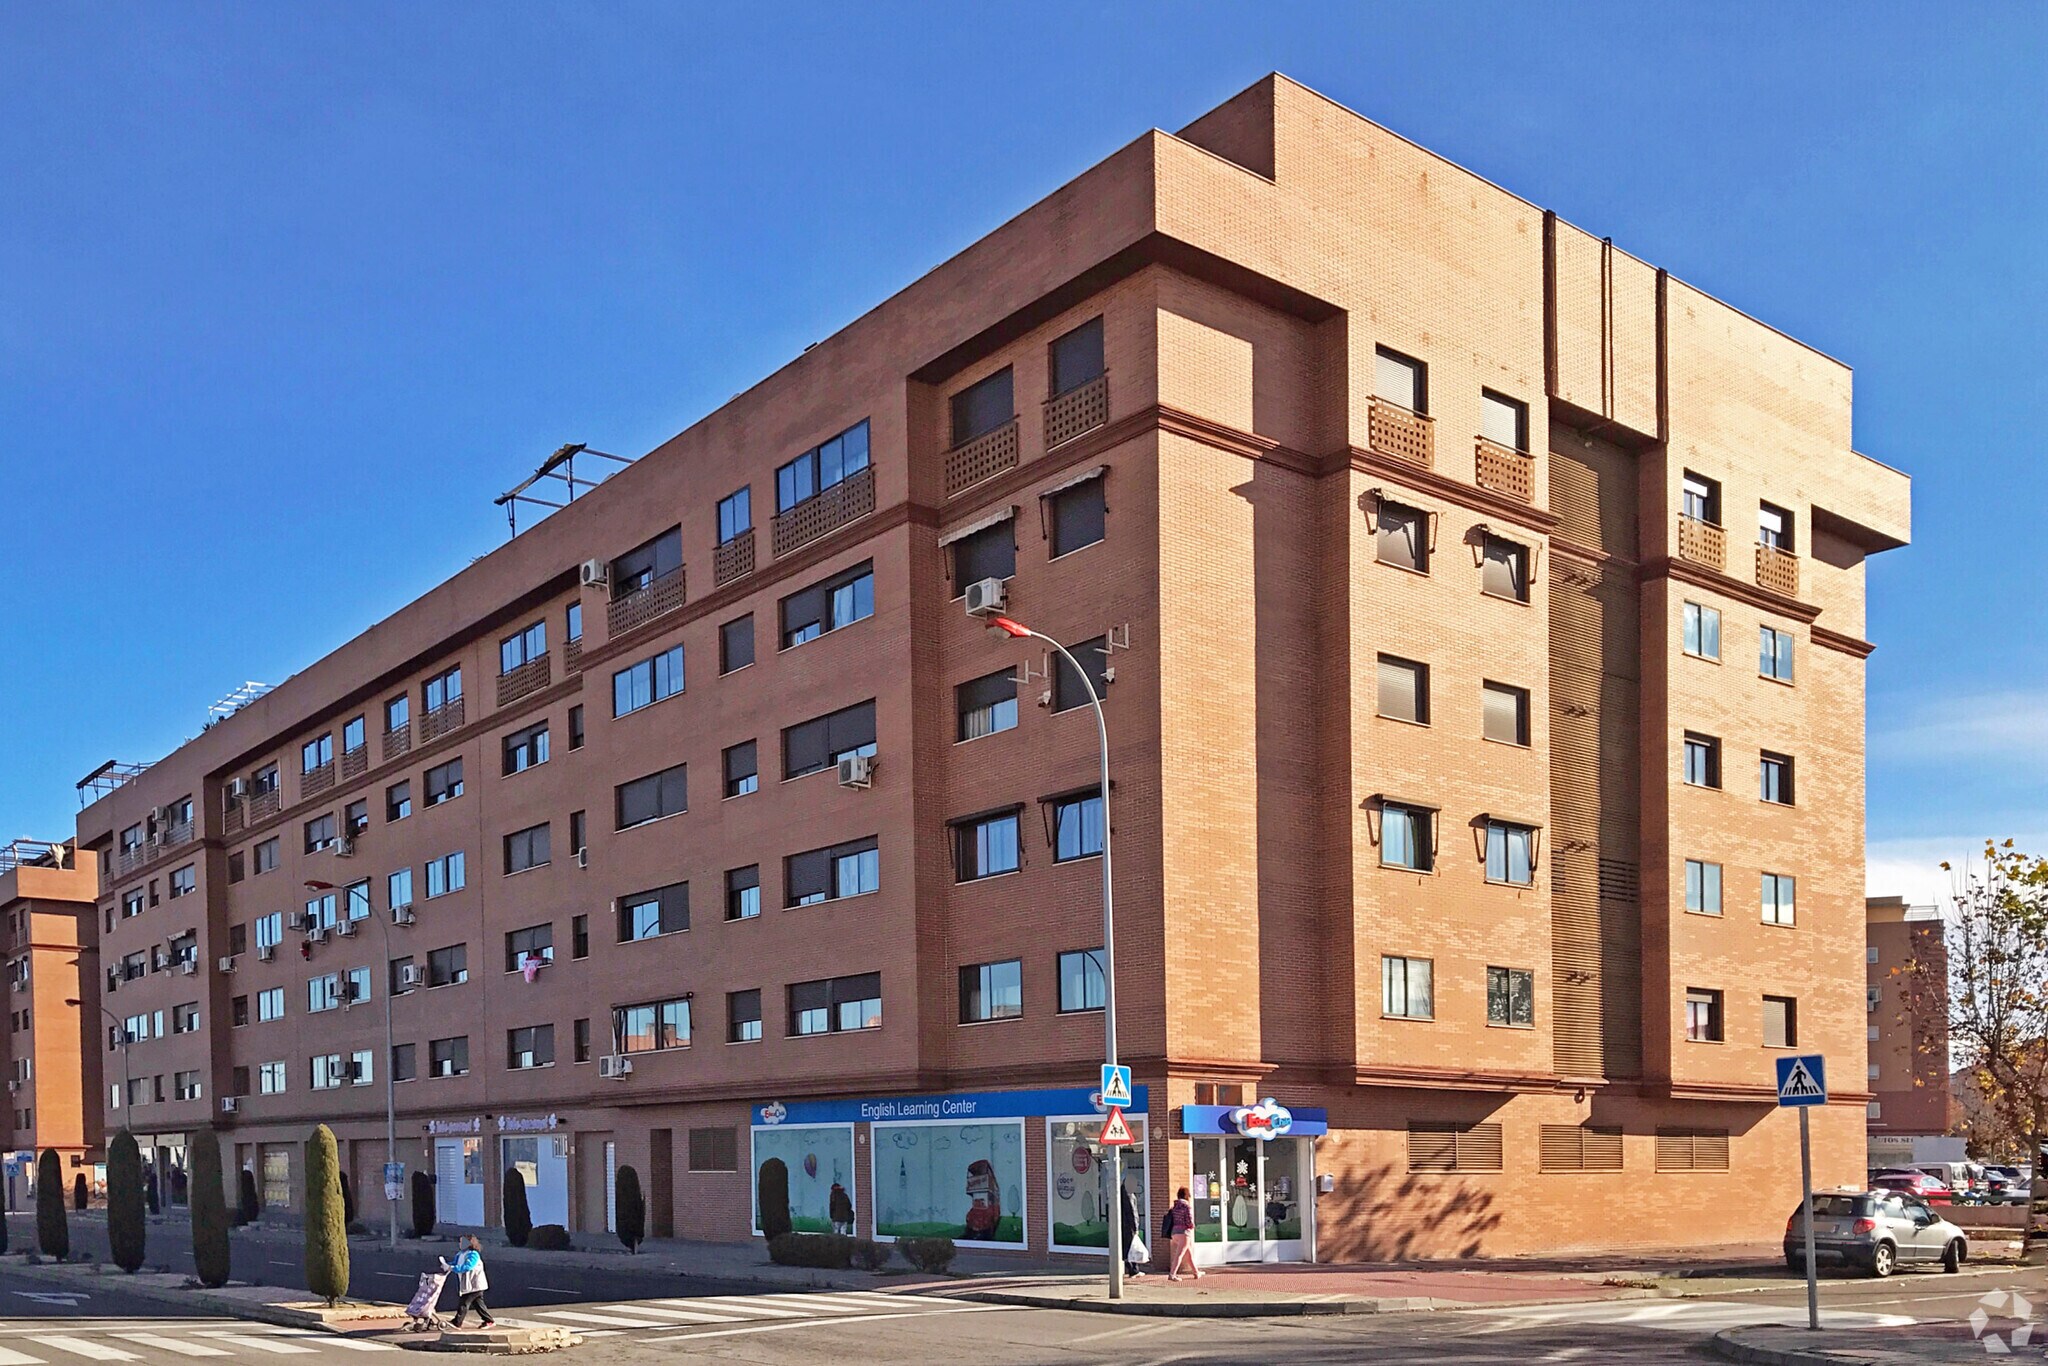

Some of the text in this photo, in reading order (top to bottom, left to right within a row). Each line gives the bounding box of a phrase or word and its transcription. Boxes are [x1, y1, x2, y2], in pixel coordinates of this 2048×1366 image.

[861, 1099, 977, 1119] English Learning Center
